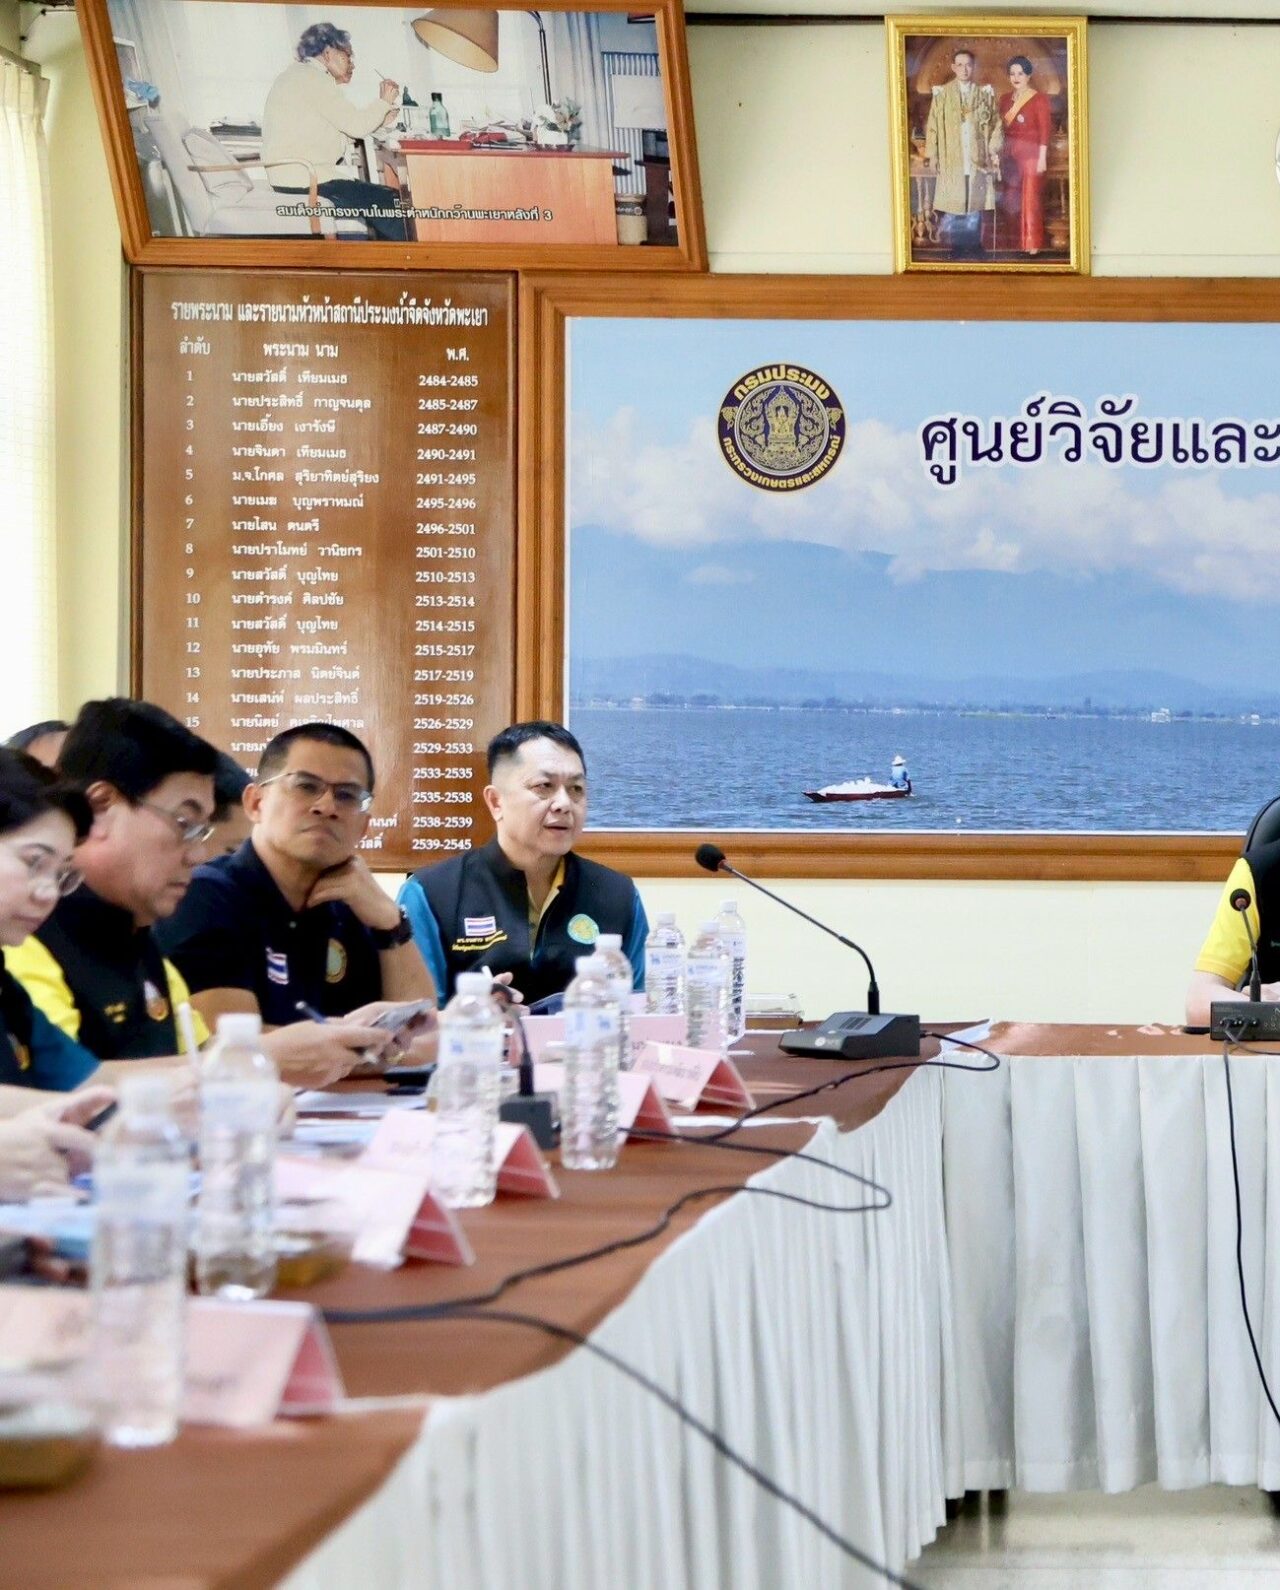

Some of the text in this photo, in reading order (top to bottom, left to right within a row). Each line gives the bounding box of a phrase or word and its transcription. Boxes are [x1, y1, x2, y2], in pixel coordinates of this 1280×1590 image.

[544, 211, 553, 221] 3
[171, 302, 233, 320] รายพระนาม
[180, 336, 469, 361] ลำดับ พระนาม นาม พ.ศ.
[187, 371, 192, 381] 1
[419, 375, 478, 386] 2484-2485
[734, 365, 830, 400] กรมประมง
[187, 395, 194, 406] 2
[419, 399, 478, 410] 2485-2487
[187, 419, 194, 430] 3
[418, 423, 477, 435] 2487-2490
[186, 445, 193, 455] 4
[418, 449, 475, 460] 2490-2491
[186, 469, 193, 480] 5
[417, 473, 475, 484] 2491-2495
[185, 495, 193, 505] 6
[417, 498, 476, 509] 2495-2496
[186, 518, 194, 529] 7
[417, 523, 475, 534] 2496-2501
[186, 543, 193, 553] 8
[416, 547, 475, 558] 2501-2510
[186, 568, 194, 578] 9
[297, 567, 338, 585] บุญไทย
[416, 571, 475, 583] 2510-2513
[186, 593, 200, 603] 10
[416, 596, 475, 607] 2513-2514
[187, 617, 198, 627] 11
[297, 616, 338, 633] บุญไทย
[416, 620, 475, 631] 2514-2515
[187, 642, 200, 653] 12
[415, 645, 475, 656] 2515-2517
[186, 667, 200, 677] 13
[415, 670, 473, 681] 2517-2519
[187, 692, 199, 702] 14
[415, 694, 474, 705] 2519-2526
[186, 716, 200, 727] 15
[414, 718, 473, 729] 2526-2529
[414, 743, 473, 754] 2529-2533
[414, 768, 472, 778] 2533-2535
[412, 792, 472, 803] 2535-2538
[413, 817, 472, 827] 2538-2539
[413, 839, 471, 849] 2539-2545
